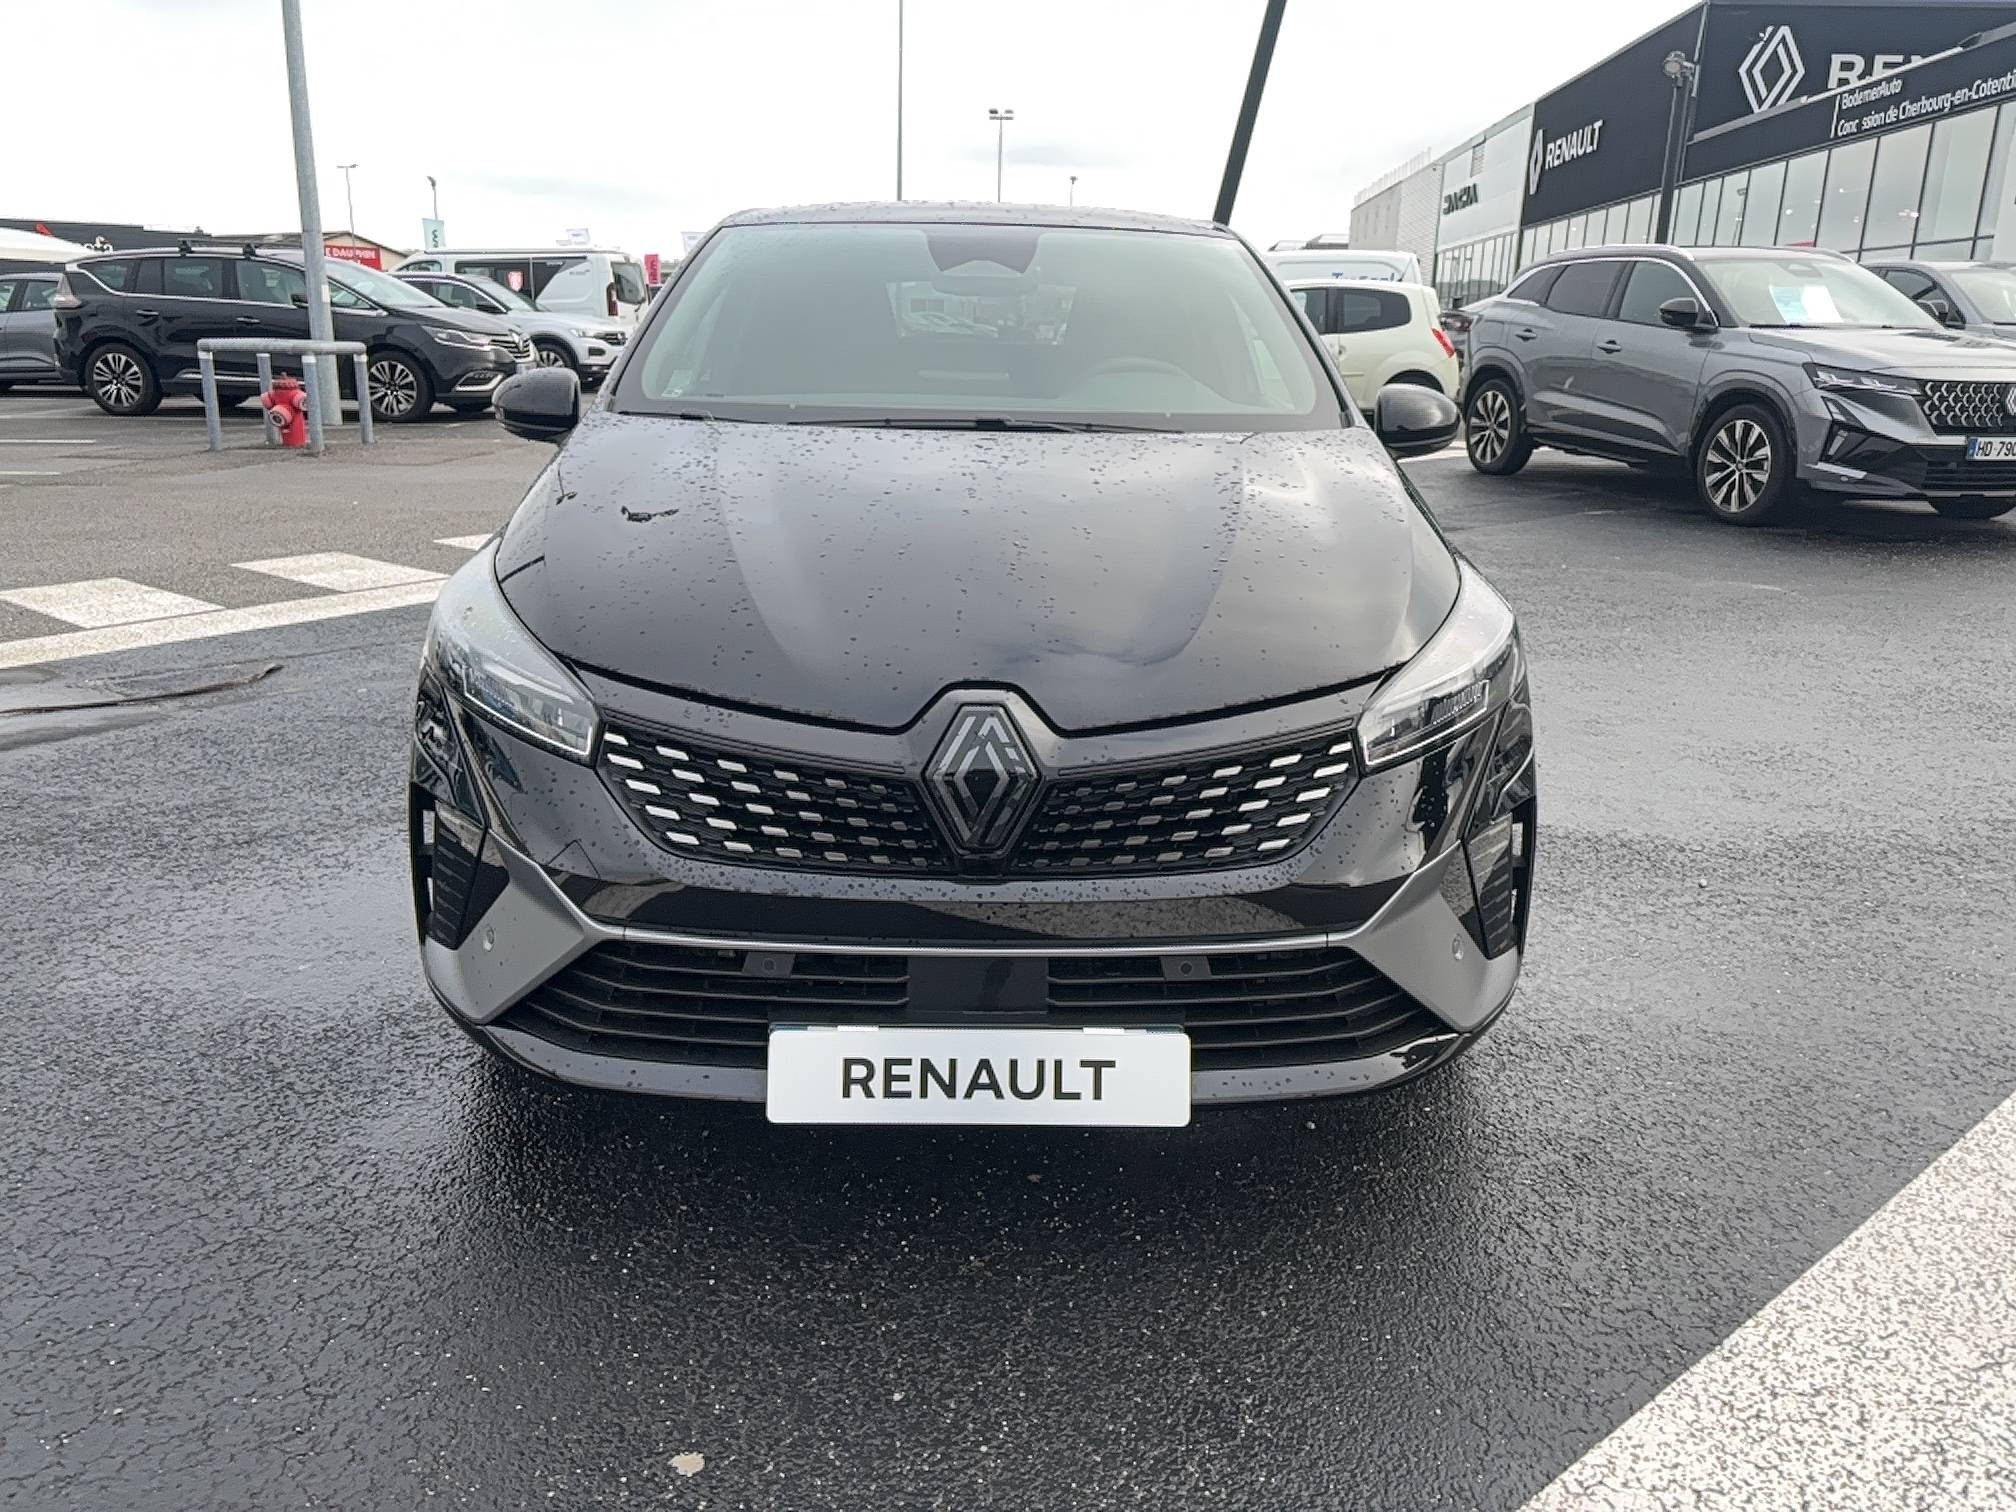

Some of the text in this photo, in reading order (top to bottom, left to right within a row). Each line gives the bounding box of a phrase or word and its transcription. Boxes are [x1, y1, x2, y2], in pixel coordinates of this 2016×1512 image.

[1827, 53, 1923, 89] RE
[1885, 104, 1899, 124] de
[1545, 119, 1604, 170] RENAULT
[842, 1057, 1117, 1101] RENAULT
